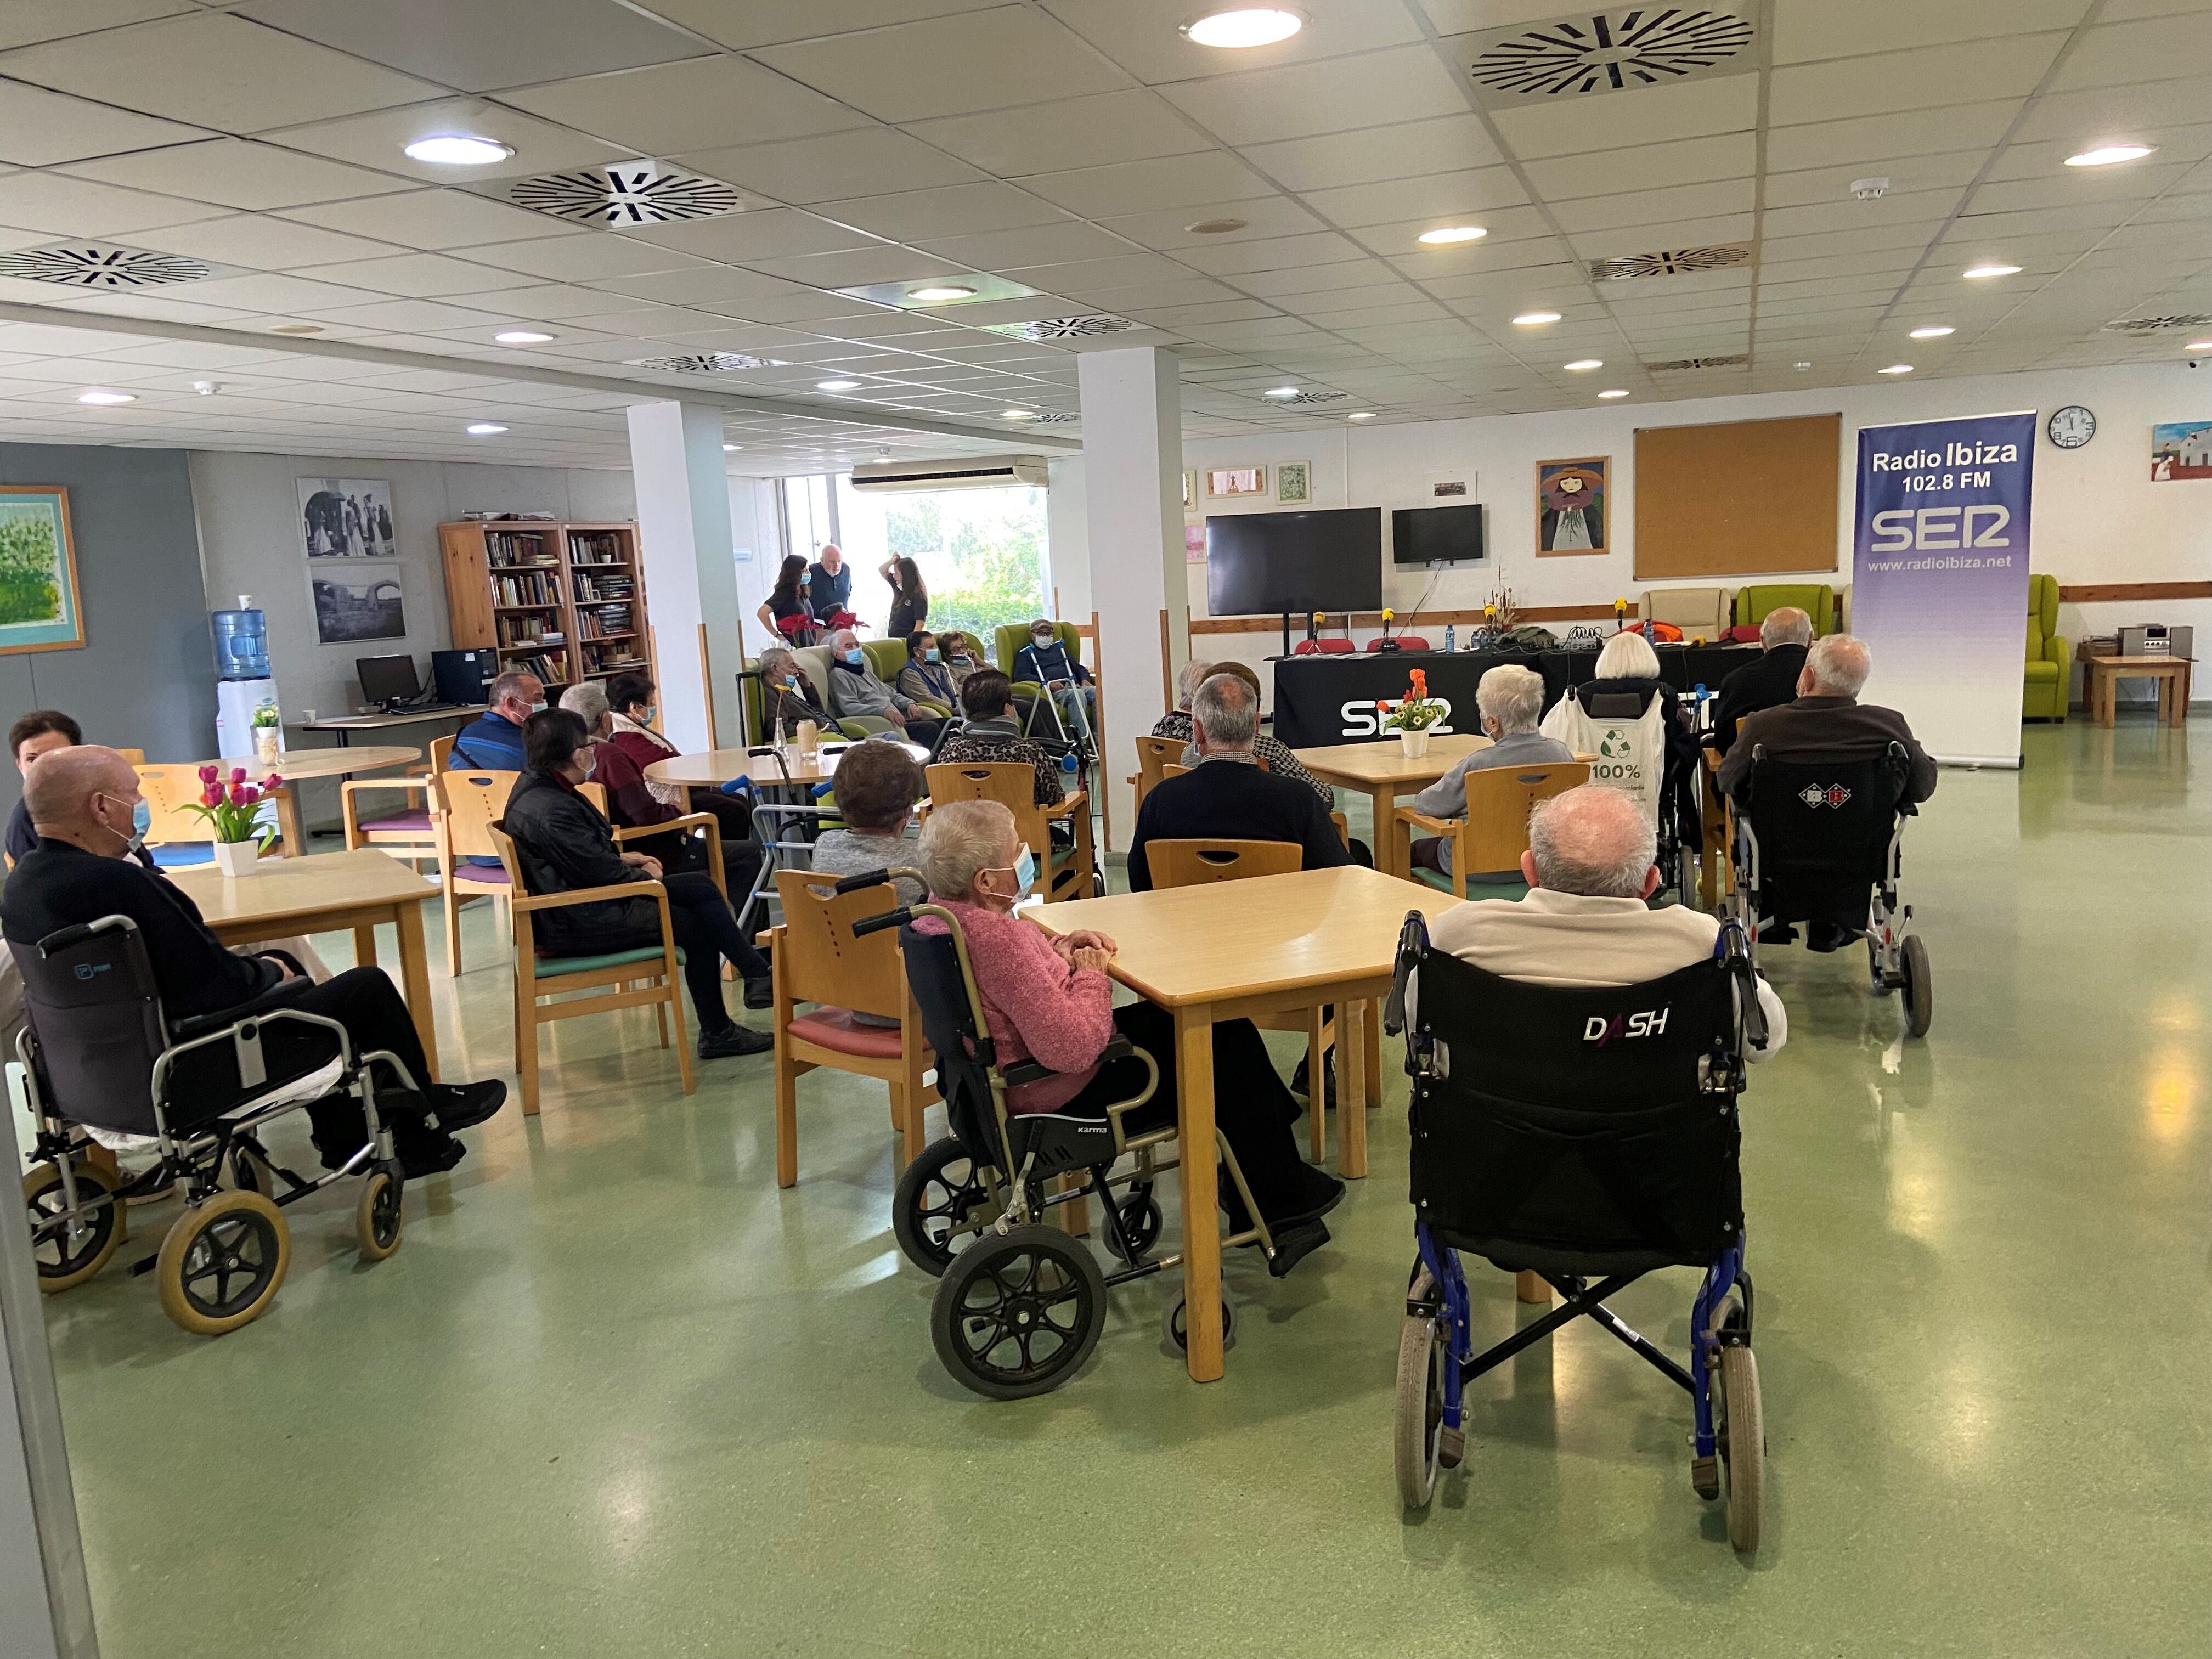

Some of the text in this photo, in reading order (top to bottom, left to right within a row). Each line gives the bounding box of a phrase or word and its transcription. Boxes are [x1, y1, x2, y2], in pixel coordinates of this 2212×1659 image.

[2086, 422, 2094, 430] 3
[2053, 432, 2061, 440] 8
[2066, 436, 2078, 447] 6
[1873, 441, 2017, 472] Radio Ibiza
[1902, 471, 1991, 492] 102.8 FM
[1871, 504, 2010, 552] SER
[1867, 555, 2012, 572] www.radioibiza.net
[1592, 765, 1640, 778] 100%
[1583, 1007, 1669, 1047] DASH
